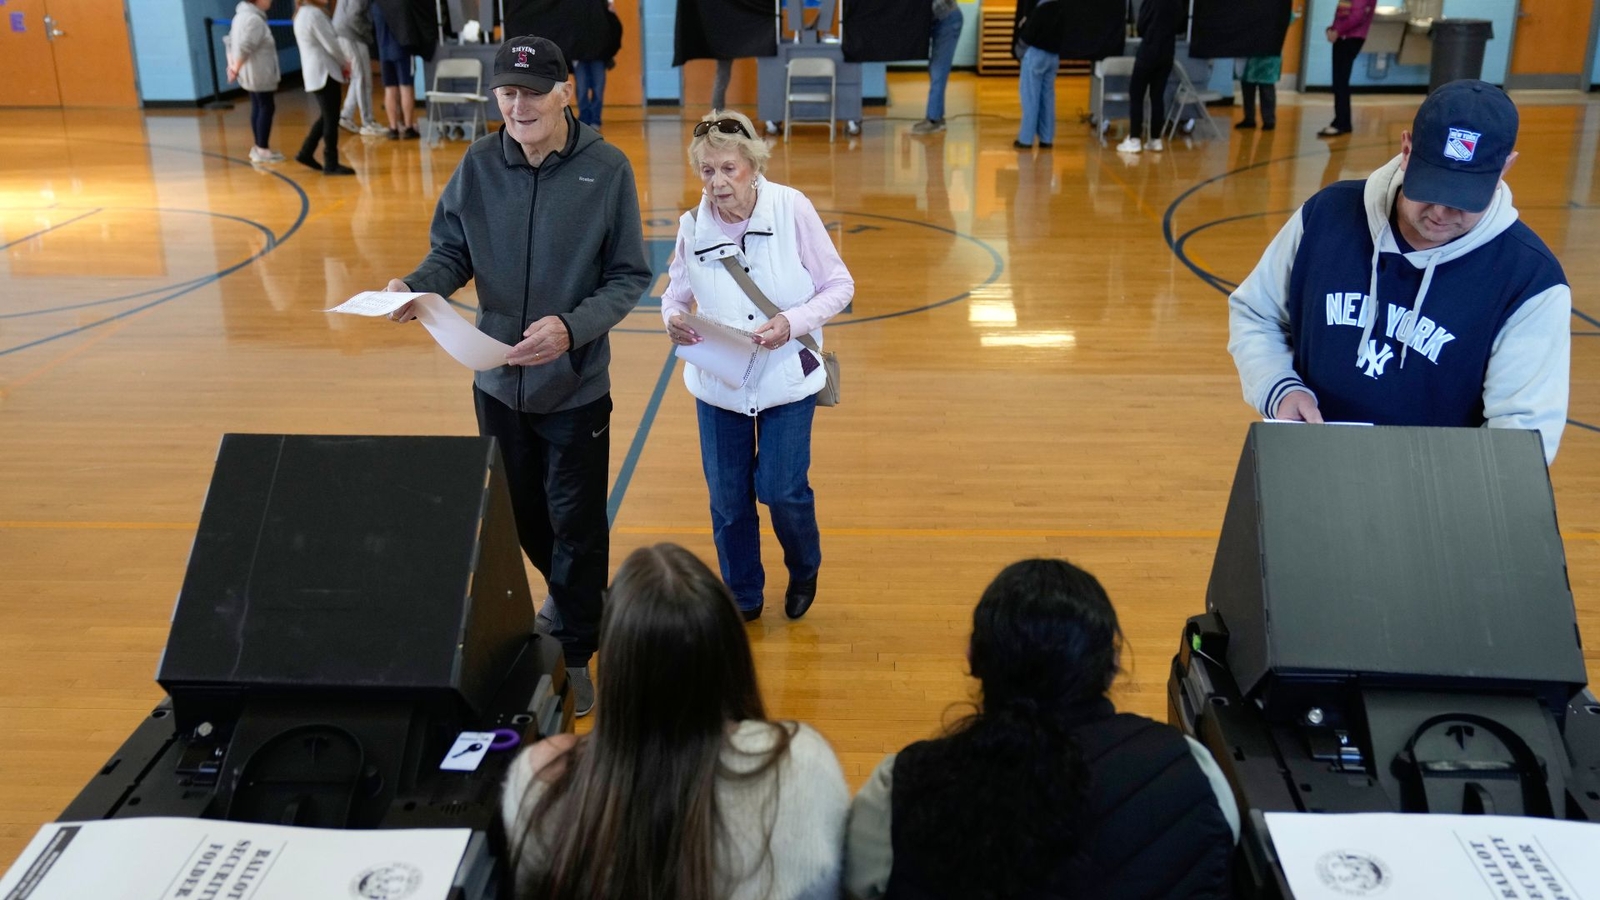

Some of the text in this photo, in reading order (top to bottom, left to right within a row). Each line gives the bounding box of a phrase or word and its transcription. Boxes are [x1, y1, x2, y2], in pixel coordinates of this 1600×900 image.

[511, 46, 536, 55] STEVENS
[518, 51, 528, 64] S
[1359, 340, 1394, 379] NY
[1386, 303, 1456, 363] YORK
[174, 844, 225, 898] FOLDER
[198, 839, 251, 900] SECURIT
[227, 849, 271, 900] BALLOT
[1469, 840, 1519, 899] BALLOT
[1488, 835, 1544, 900] ECURITY
